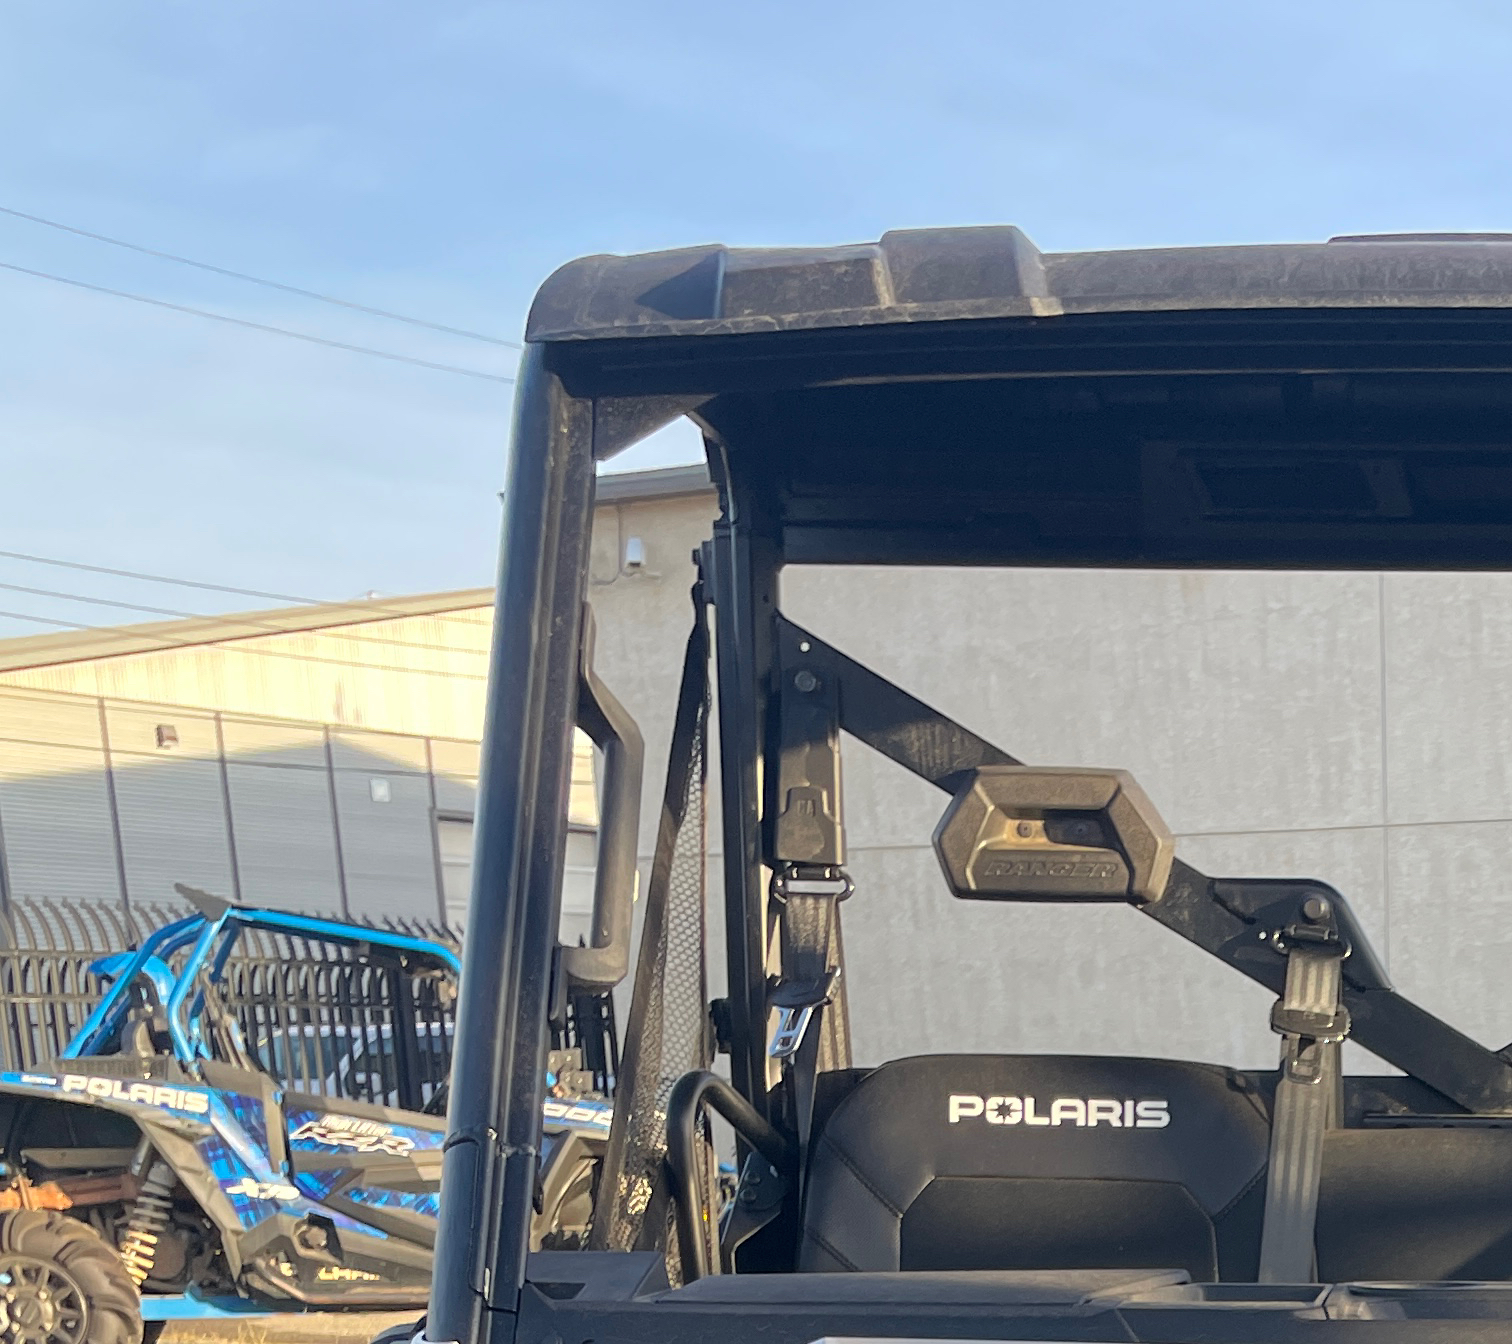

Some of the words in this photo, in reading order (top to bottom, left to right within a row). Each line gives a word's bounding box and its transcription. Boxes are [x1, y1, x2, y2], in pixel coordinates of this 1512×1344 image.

[984, 860, 1119, 877] RANGER
[62, 1074, 209, 1114] POLARIS
[949, 1095, 1171, 1128] POLARIS
